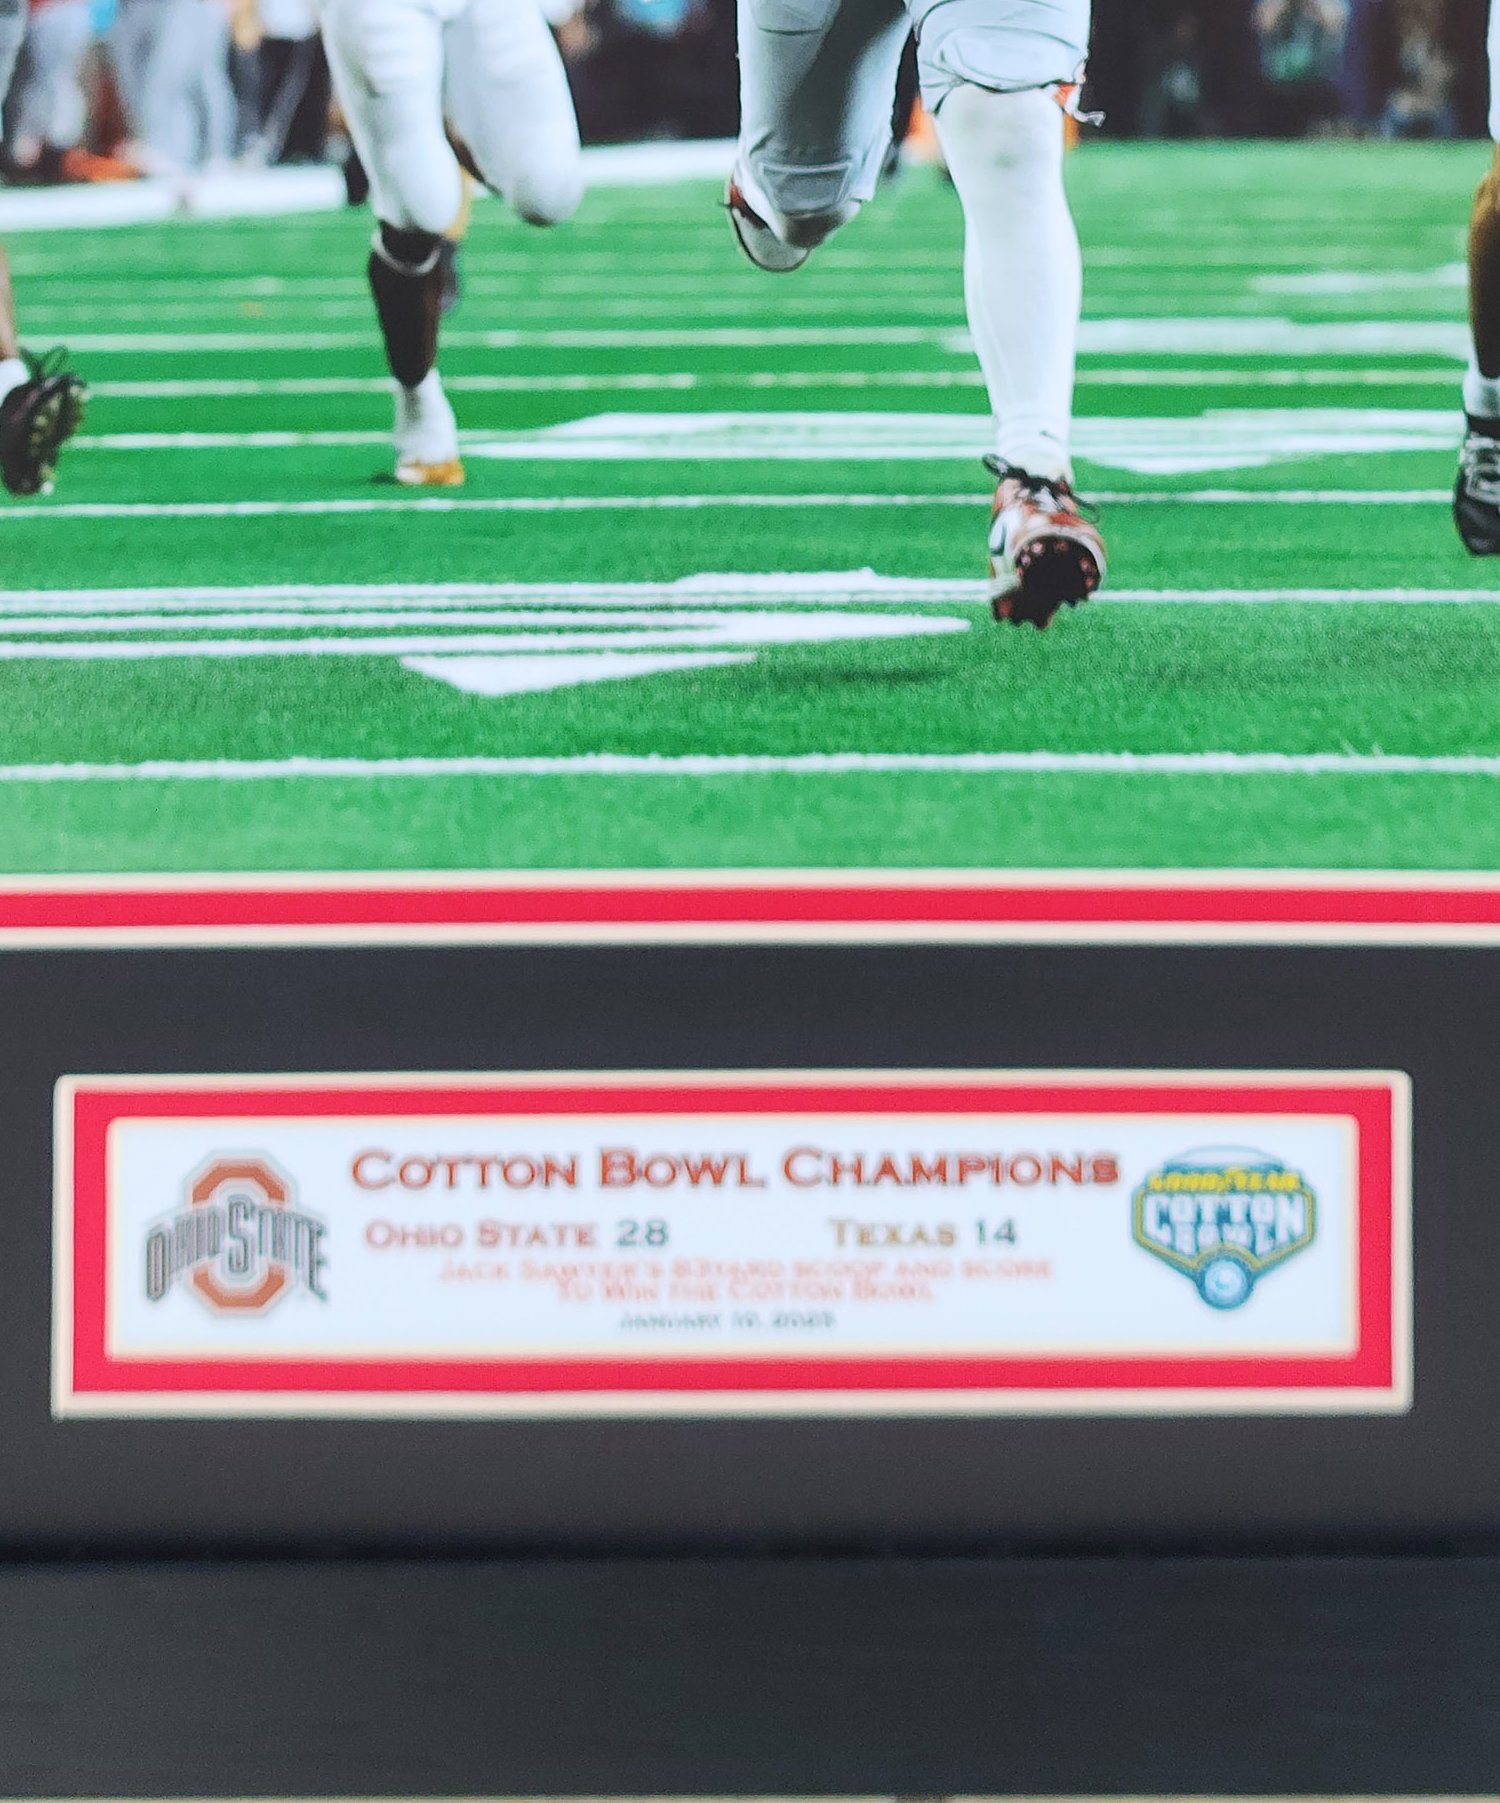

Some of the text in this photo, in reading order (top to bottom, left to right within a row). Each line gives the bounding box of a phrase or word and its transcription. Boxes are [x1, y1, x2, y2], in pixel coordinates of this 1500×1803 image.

[351, 1145, 1121, 1190] COTTON BOWL CHAMPIONS
[364, 1218, 669, 1248] OHIO STATE 28
[829, 1217, 1017, 1246] TEXAS 14
